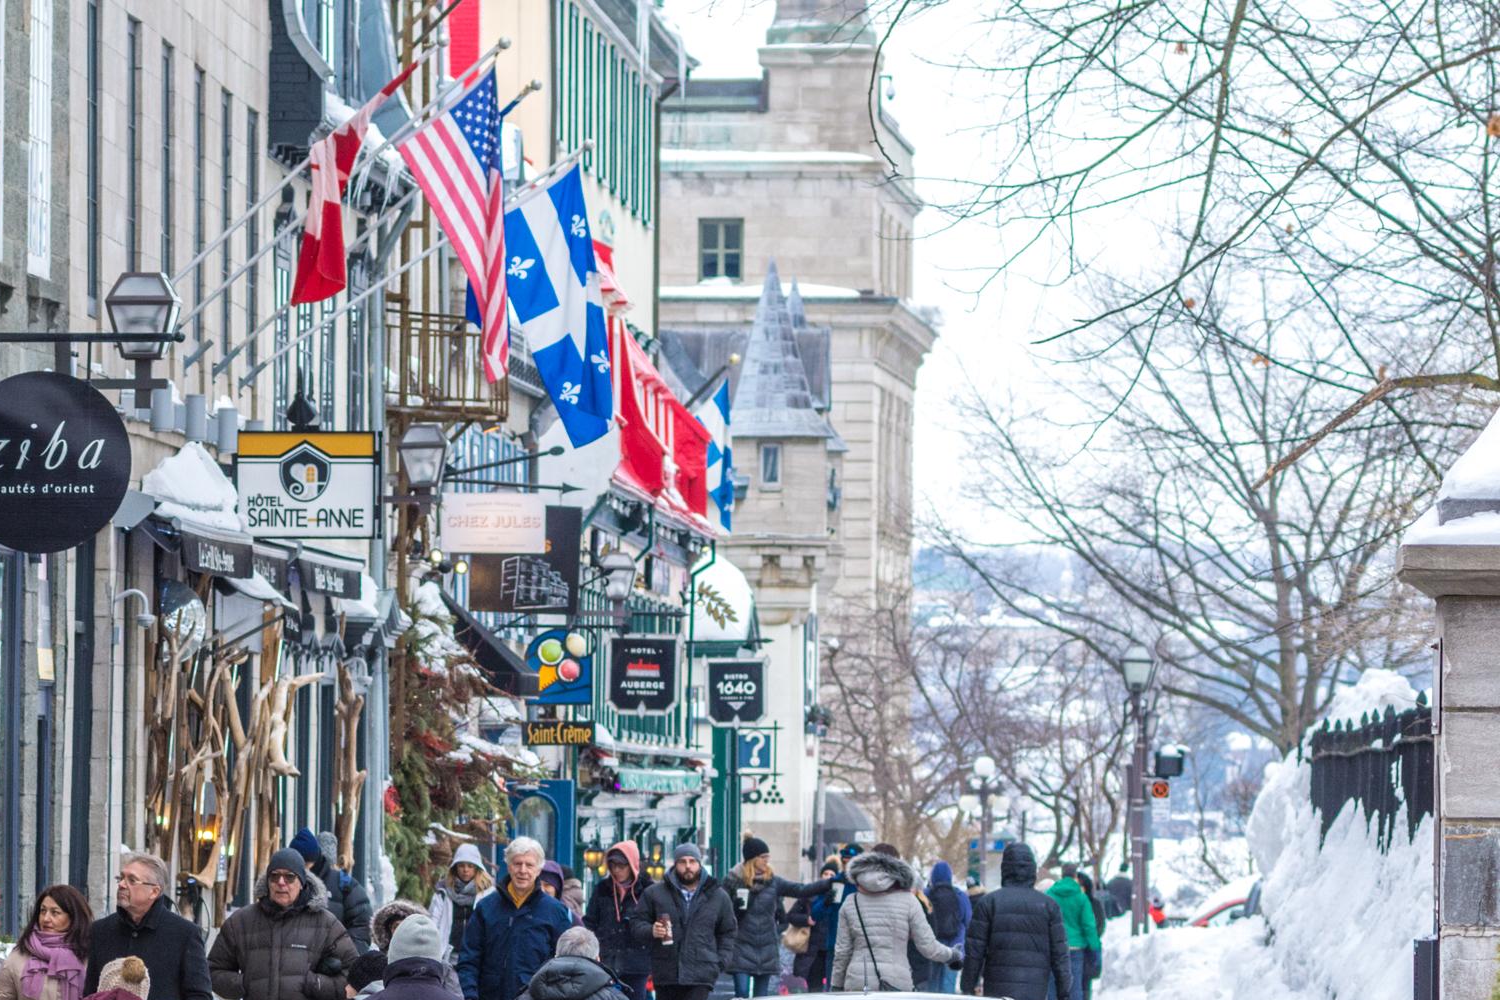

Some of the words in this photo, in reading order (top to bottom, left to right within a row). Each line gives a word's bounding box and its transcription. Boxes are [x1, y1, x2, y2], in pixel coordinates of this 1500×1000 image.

[42, 484, 95, 494] d'orient
[247, 493, 284, 507] HÔTEL
[247, 508, 364, 528] SAINTE-ANNE
[447, 514, 489, 528] CHEZ
[491, 514, 542, 529] JULES
[630, 647, 657, 655] HOTEL
[723, 673, 749, 681] BISTRO
[620, 680, 665, 690] AUBERGE
[716, 681, 757, 695] 1640
[527, 722, 592, 744] Saint-Crème
